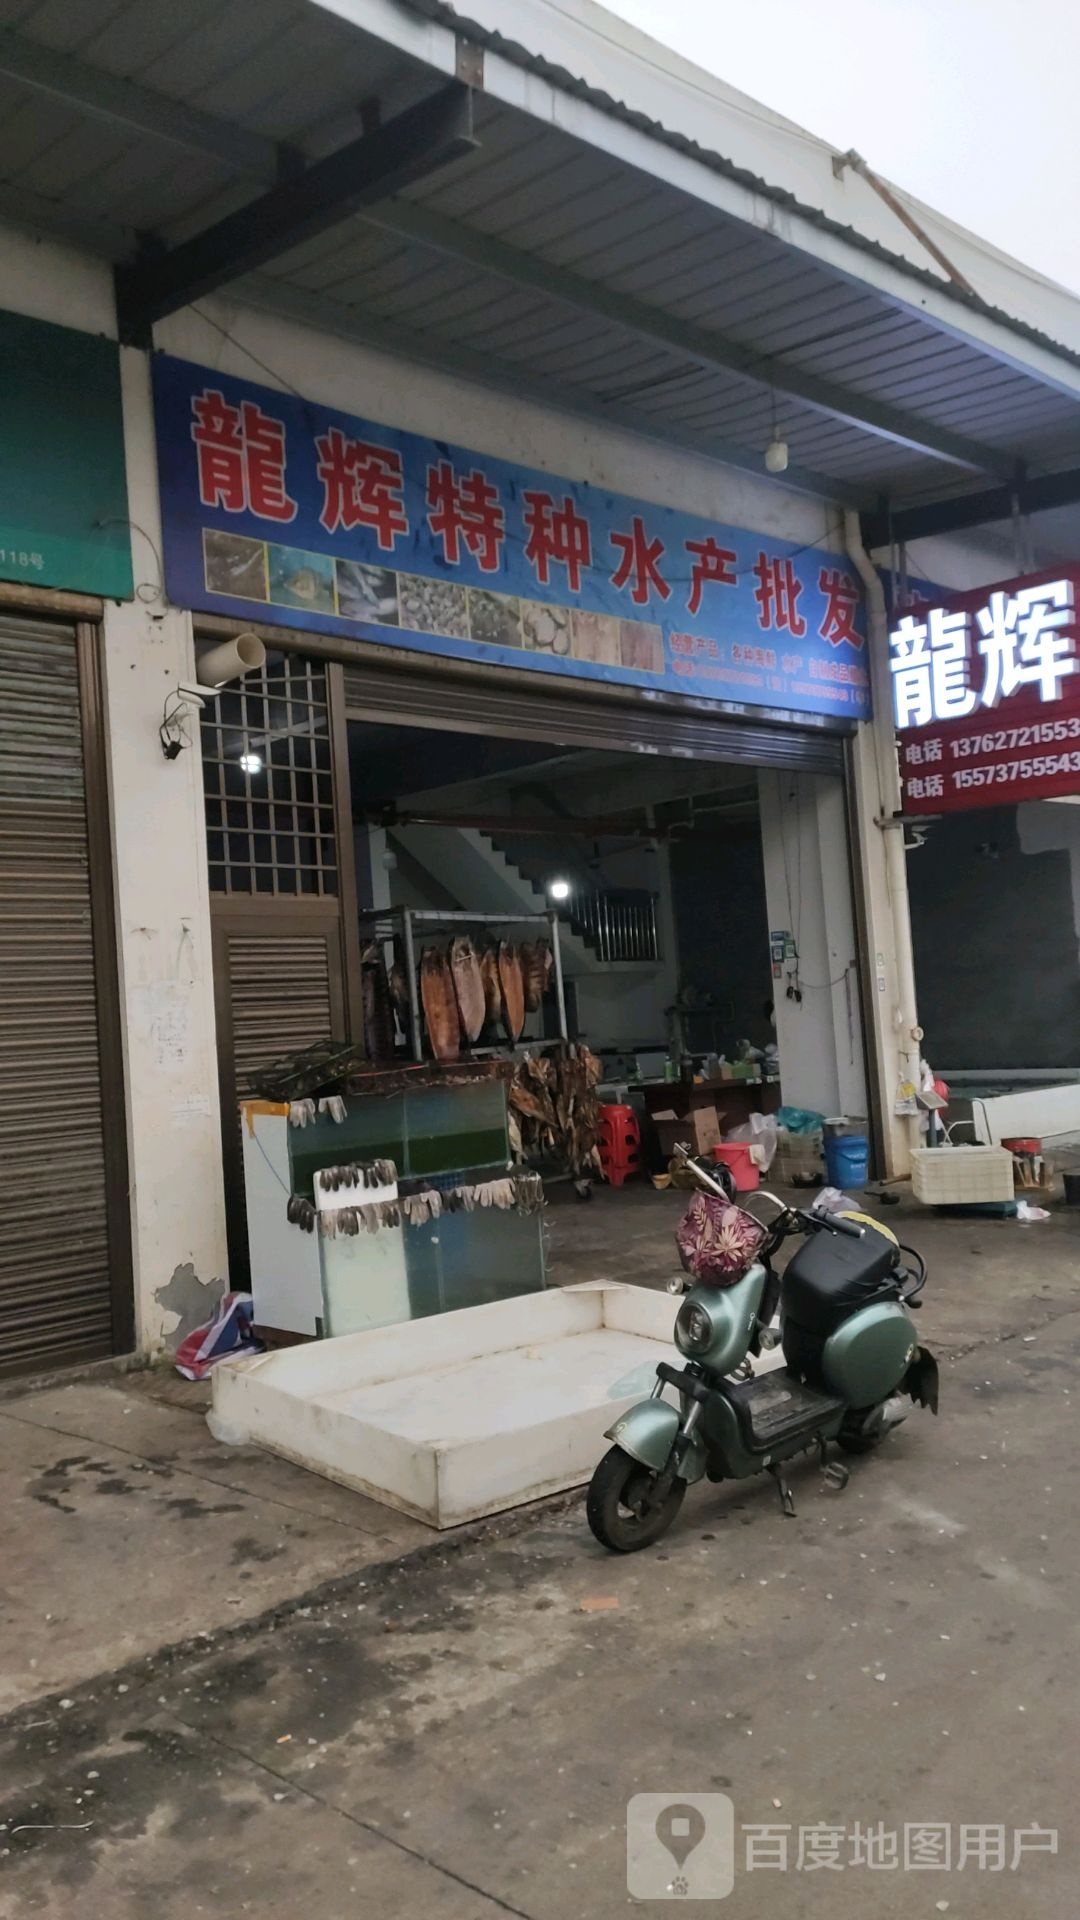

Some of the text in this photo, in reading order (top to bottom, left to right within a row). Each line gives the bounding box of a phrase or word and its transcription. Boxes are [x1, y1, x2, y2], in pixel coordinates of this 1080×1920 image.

[191, 388, 865, 649] 龍辉特种水产批发
[890, 580, 1077, 728] 龍辉
[906, 718, 1080, 765] 电话 13762721553
[908, 776, 944, 799] 电话
